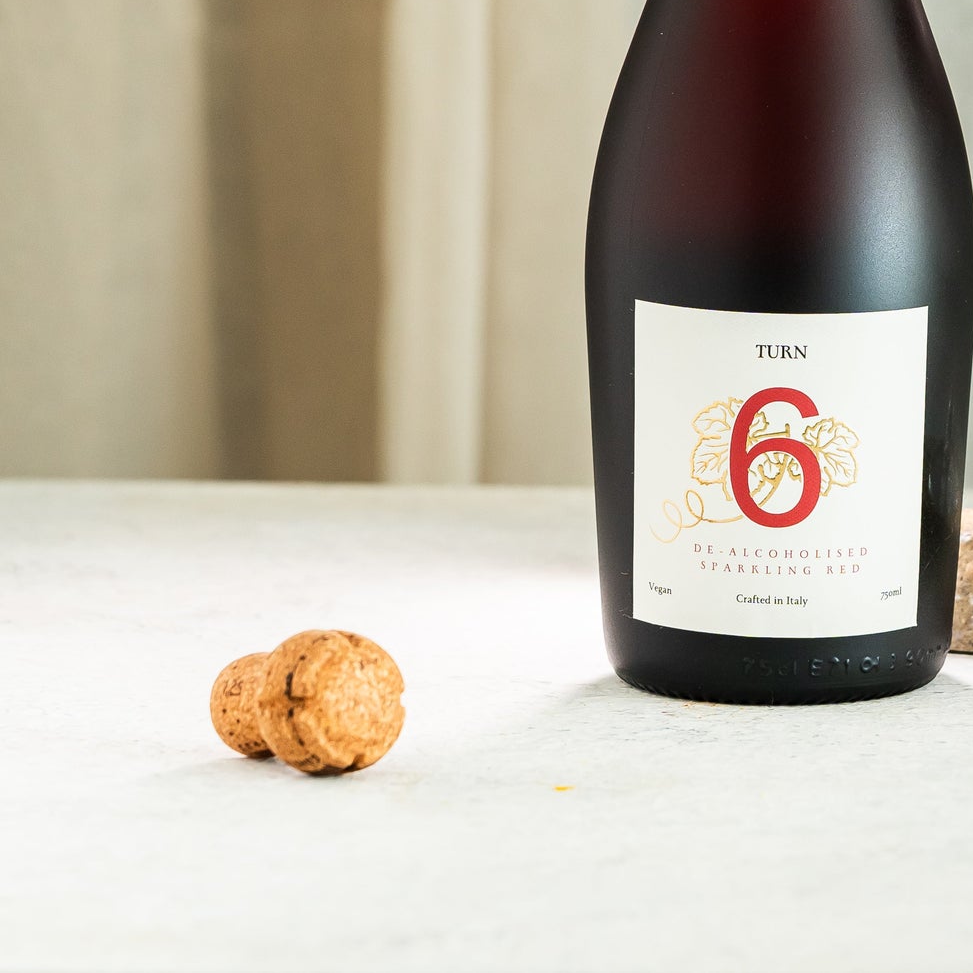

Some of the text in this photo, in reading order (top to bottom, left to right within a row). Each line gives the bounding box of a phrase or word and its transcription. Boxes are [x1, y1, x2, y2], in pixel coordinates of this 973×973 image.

[755, 344, 808, 360] TURN
[729, 387, 821, 528] 6
[694, 543, 868, 559] DE-ALCOHOLISED
[700, 560, 860, 576] SPARKLING RED
[648, 581, 672, 596] Vegan
[880, 586, 902, 601] 750ml
[736, 594, 809, 608] Crafted in Italy
